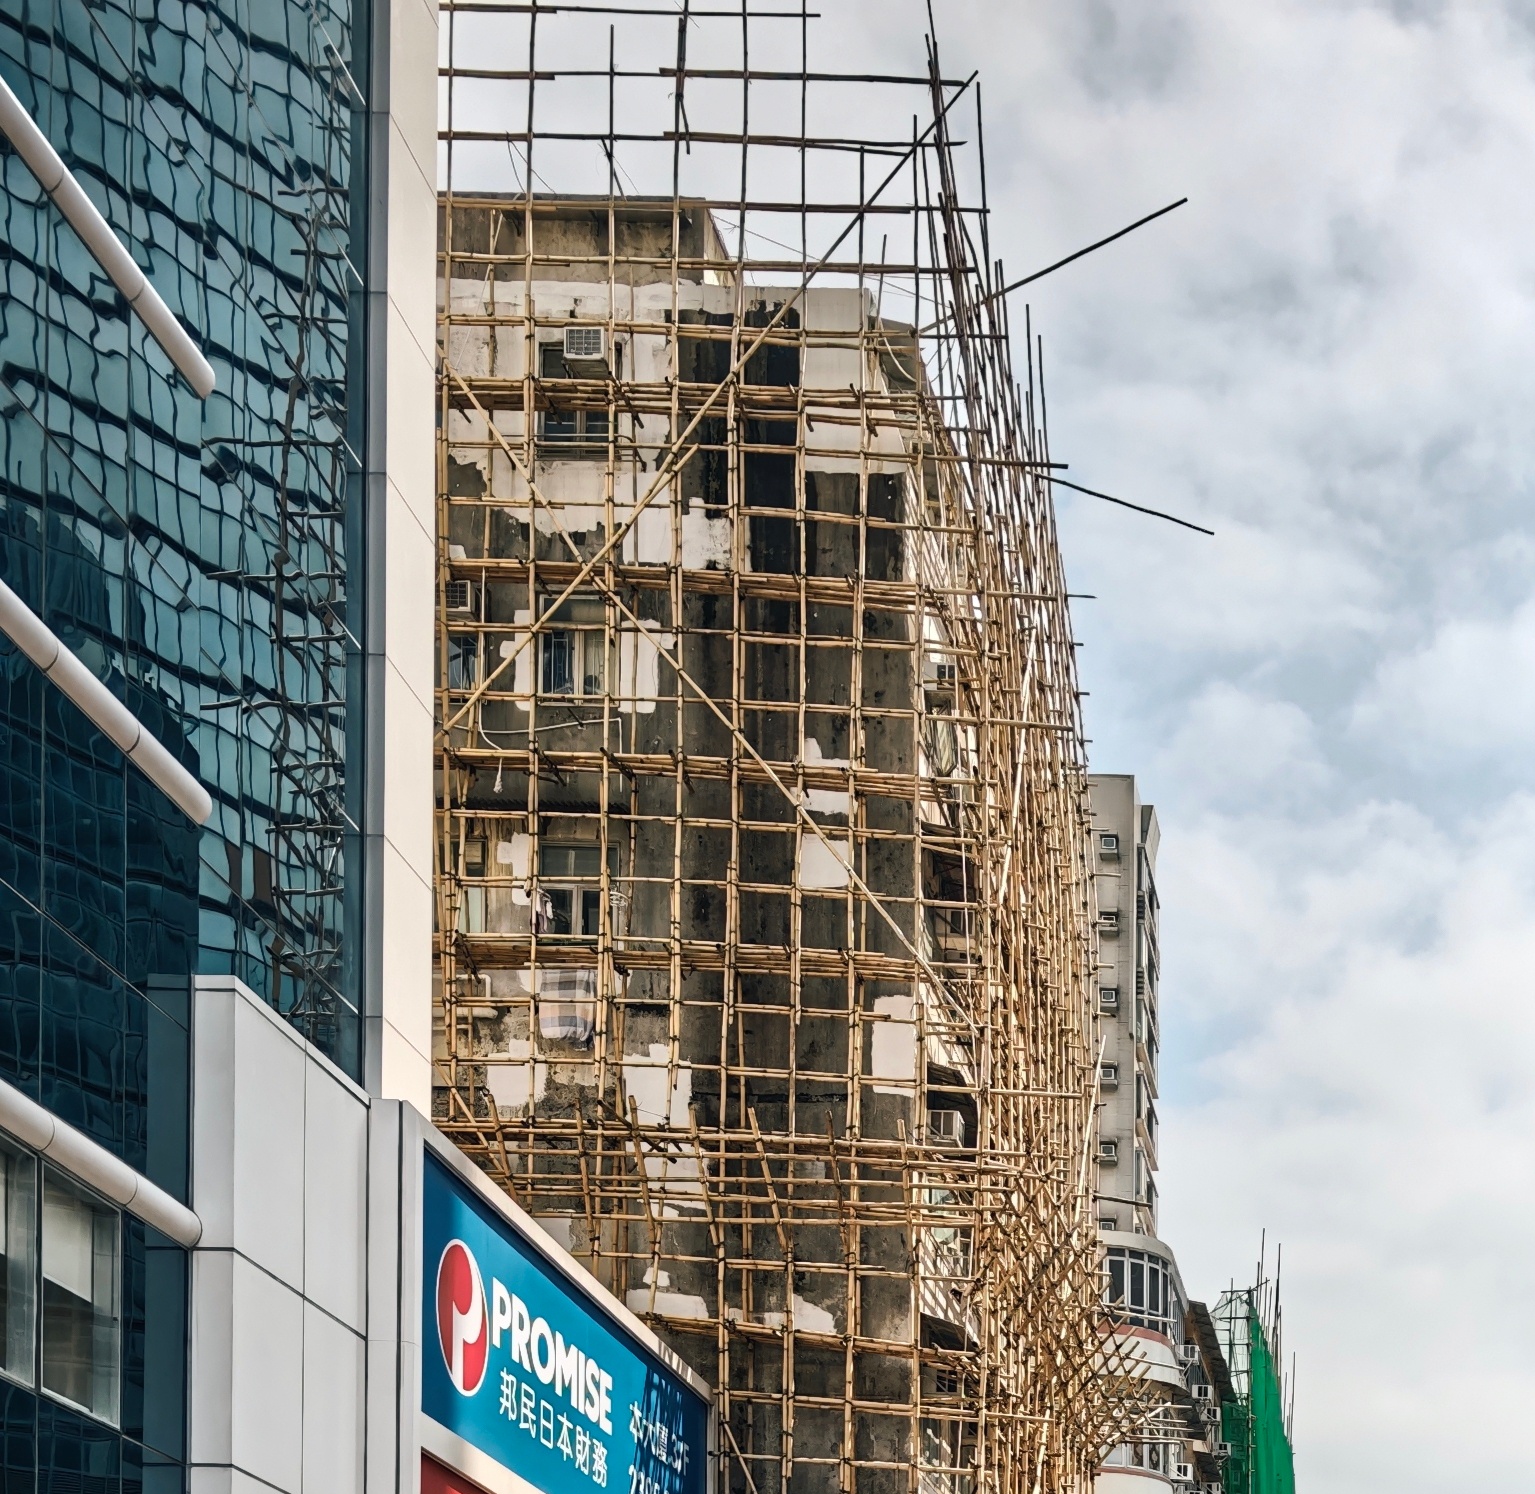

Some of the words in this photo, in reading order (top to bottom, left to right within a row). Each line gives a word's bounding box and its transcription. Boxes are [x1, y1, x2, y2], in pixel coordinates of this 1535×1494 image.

[492, 1276, 613, 1436] PROMISE
[499, 1367, 608, 1488] 邦民日本財務
